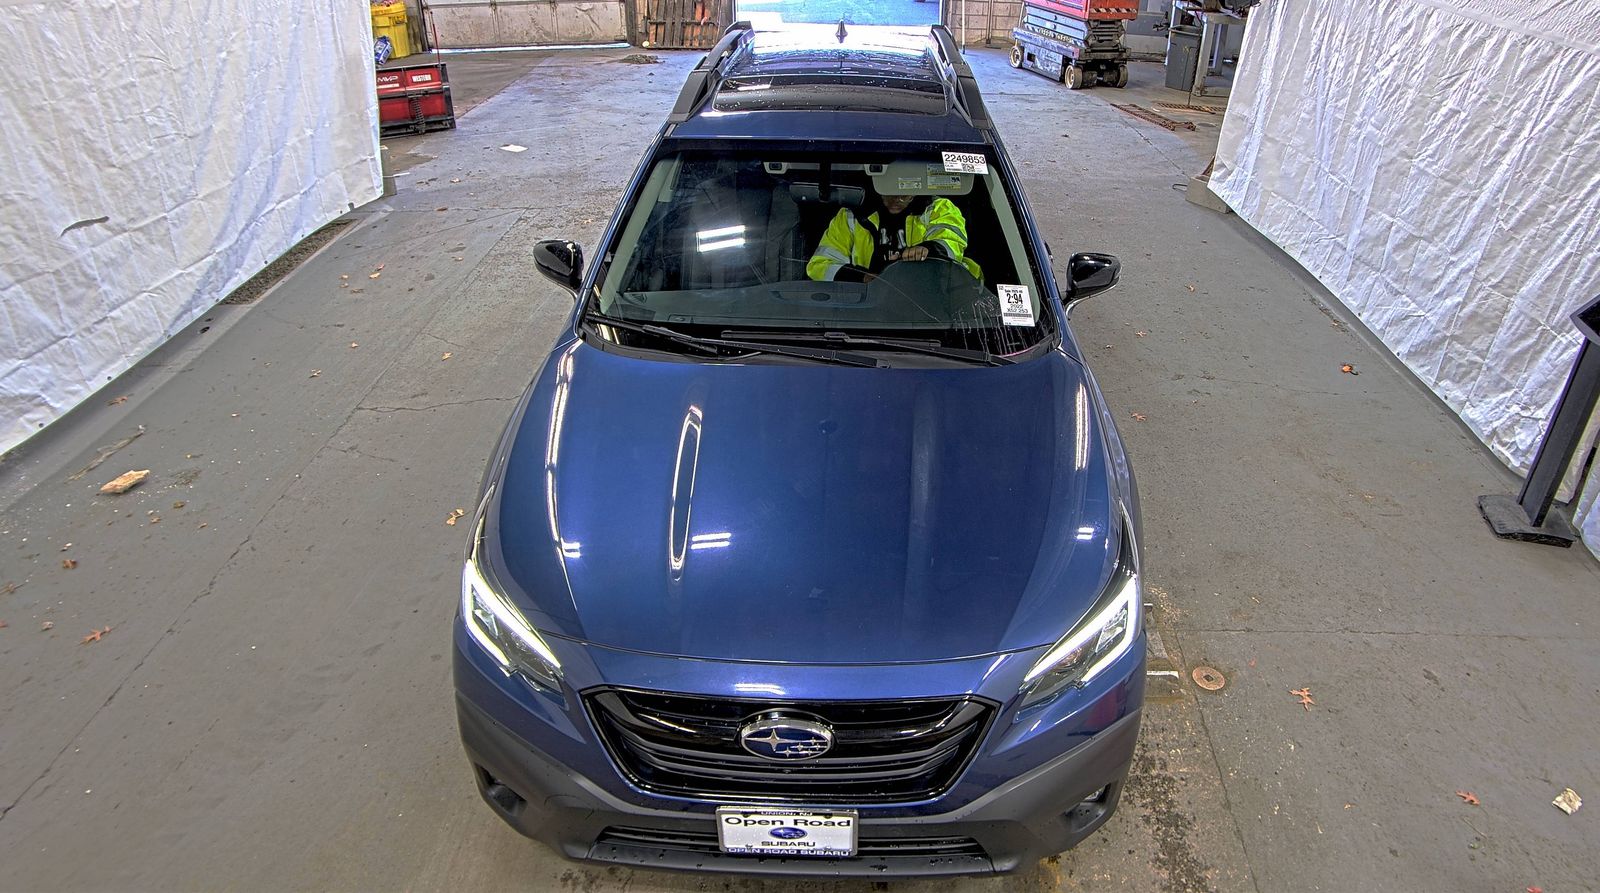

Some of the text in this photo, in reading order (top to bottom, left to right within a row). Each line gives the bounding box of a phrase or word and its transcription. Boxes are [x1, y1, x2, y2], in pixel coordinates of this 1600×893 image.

[377, 75, 399, 83] MVP
[944, 153, 986, 164] 2249853
[1006, 293, 1023, 304] 2:94
[725, 817, 851, 827] Open Road
